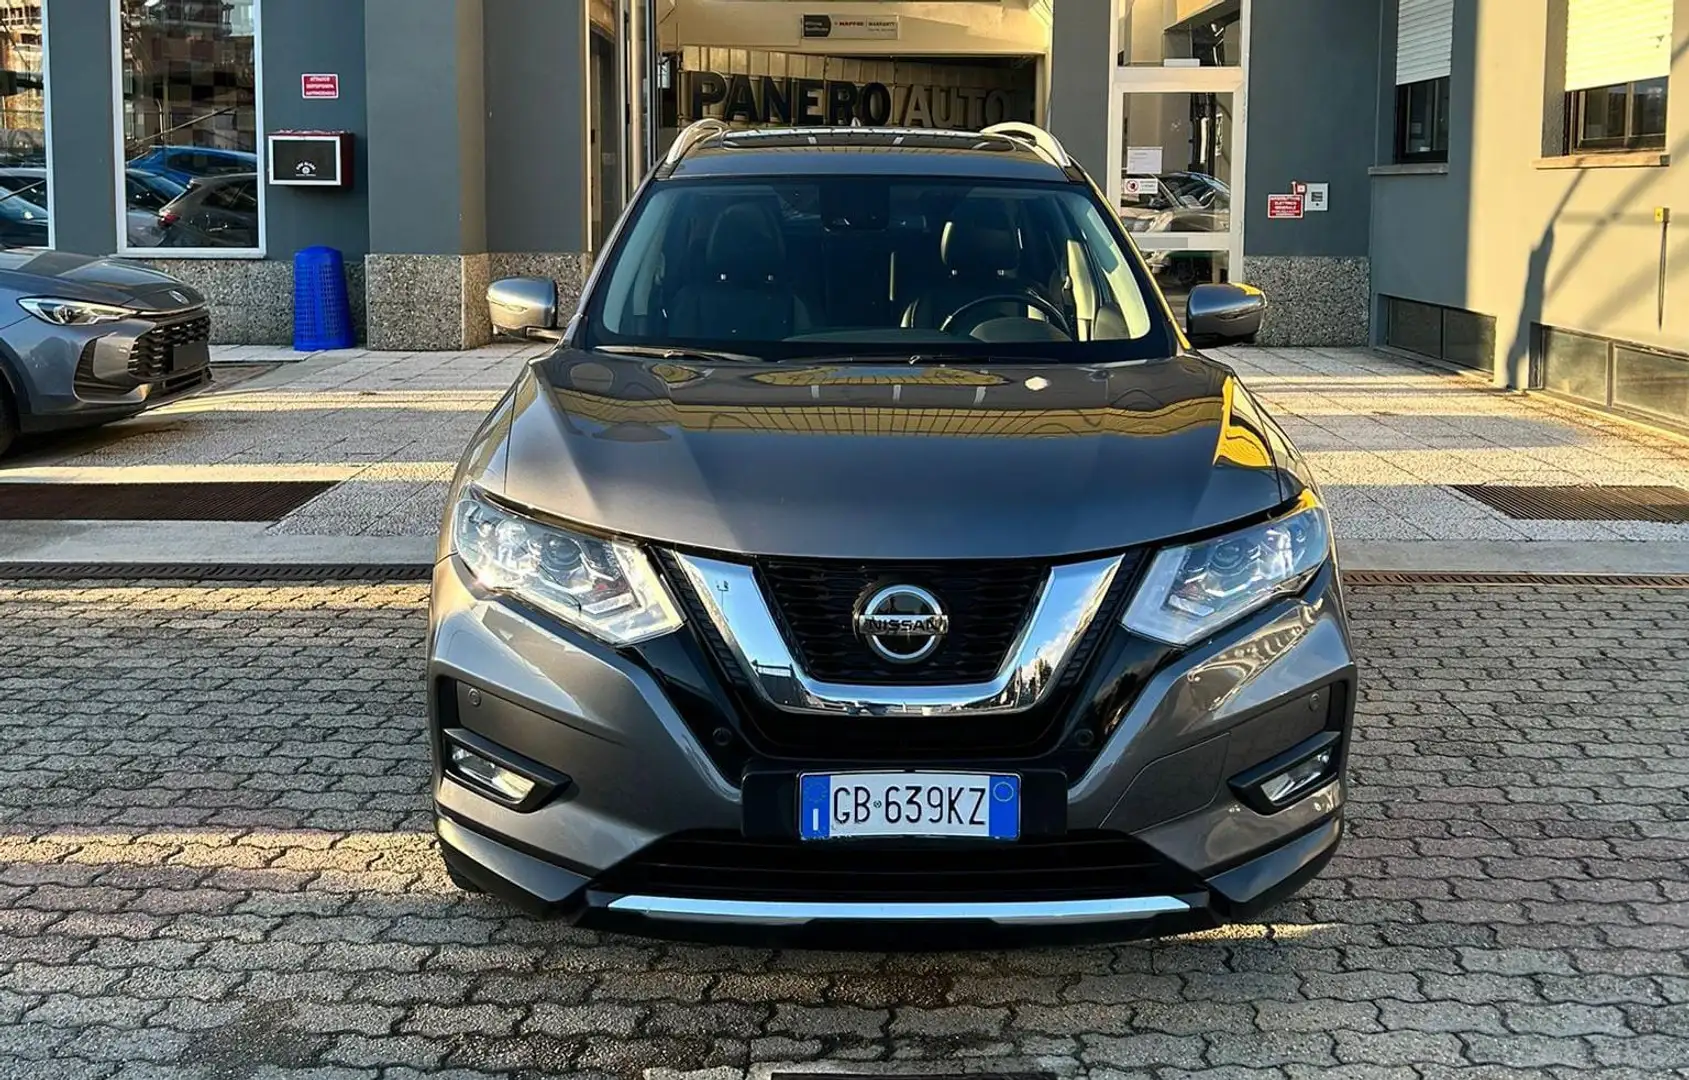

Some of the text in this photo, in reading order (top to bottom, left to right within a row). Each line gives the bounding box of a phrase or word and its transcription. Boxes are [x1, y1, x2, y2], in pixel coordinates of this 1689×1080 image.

[691, 70, 1009, 130] PANERO AUTO
[867, 618, 939, 632] NISSAN
[833, 785, 986, 826] GB 639KZ
